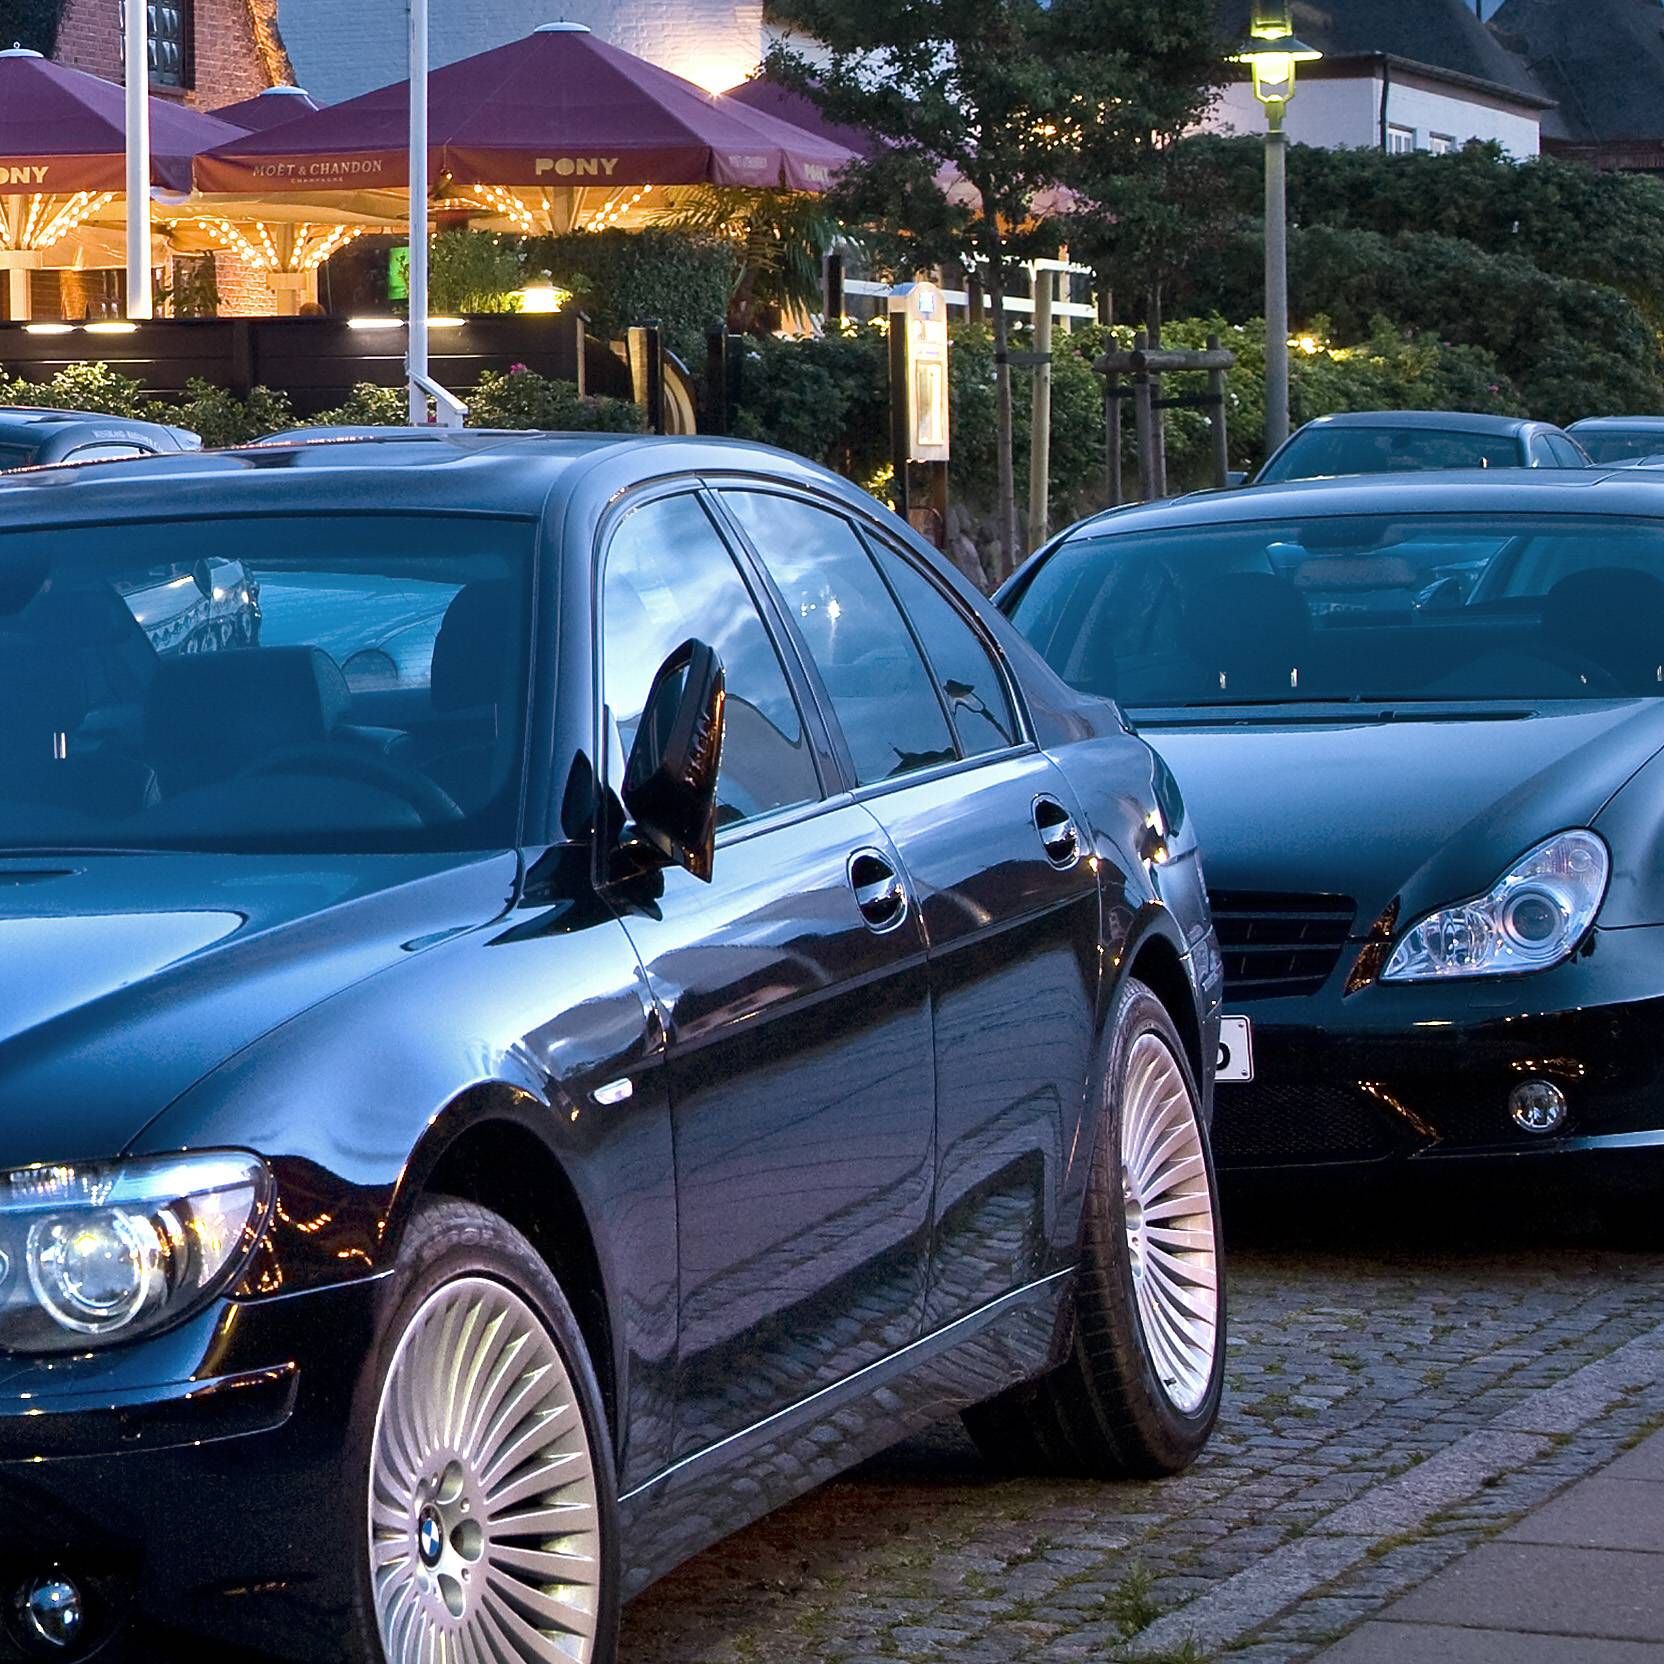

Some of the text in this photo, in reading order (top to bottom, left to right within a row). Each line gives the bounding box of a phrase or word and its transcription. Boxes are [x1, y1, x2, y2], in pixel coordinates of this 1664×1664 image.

[298, 166, 307, 176] &
[309, 159, 383, 176] CHANDON
[536, 158, 619, 176] PONY
